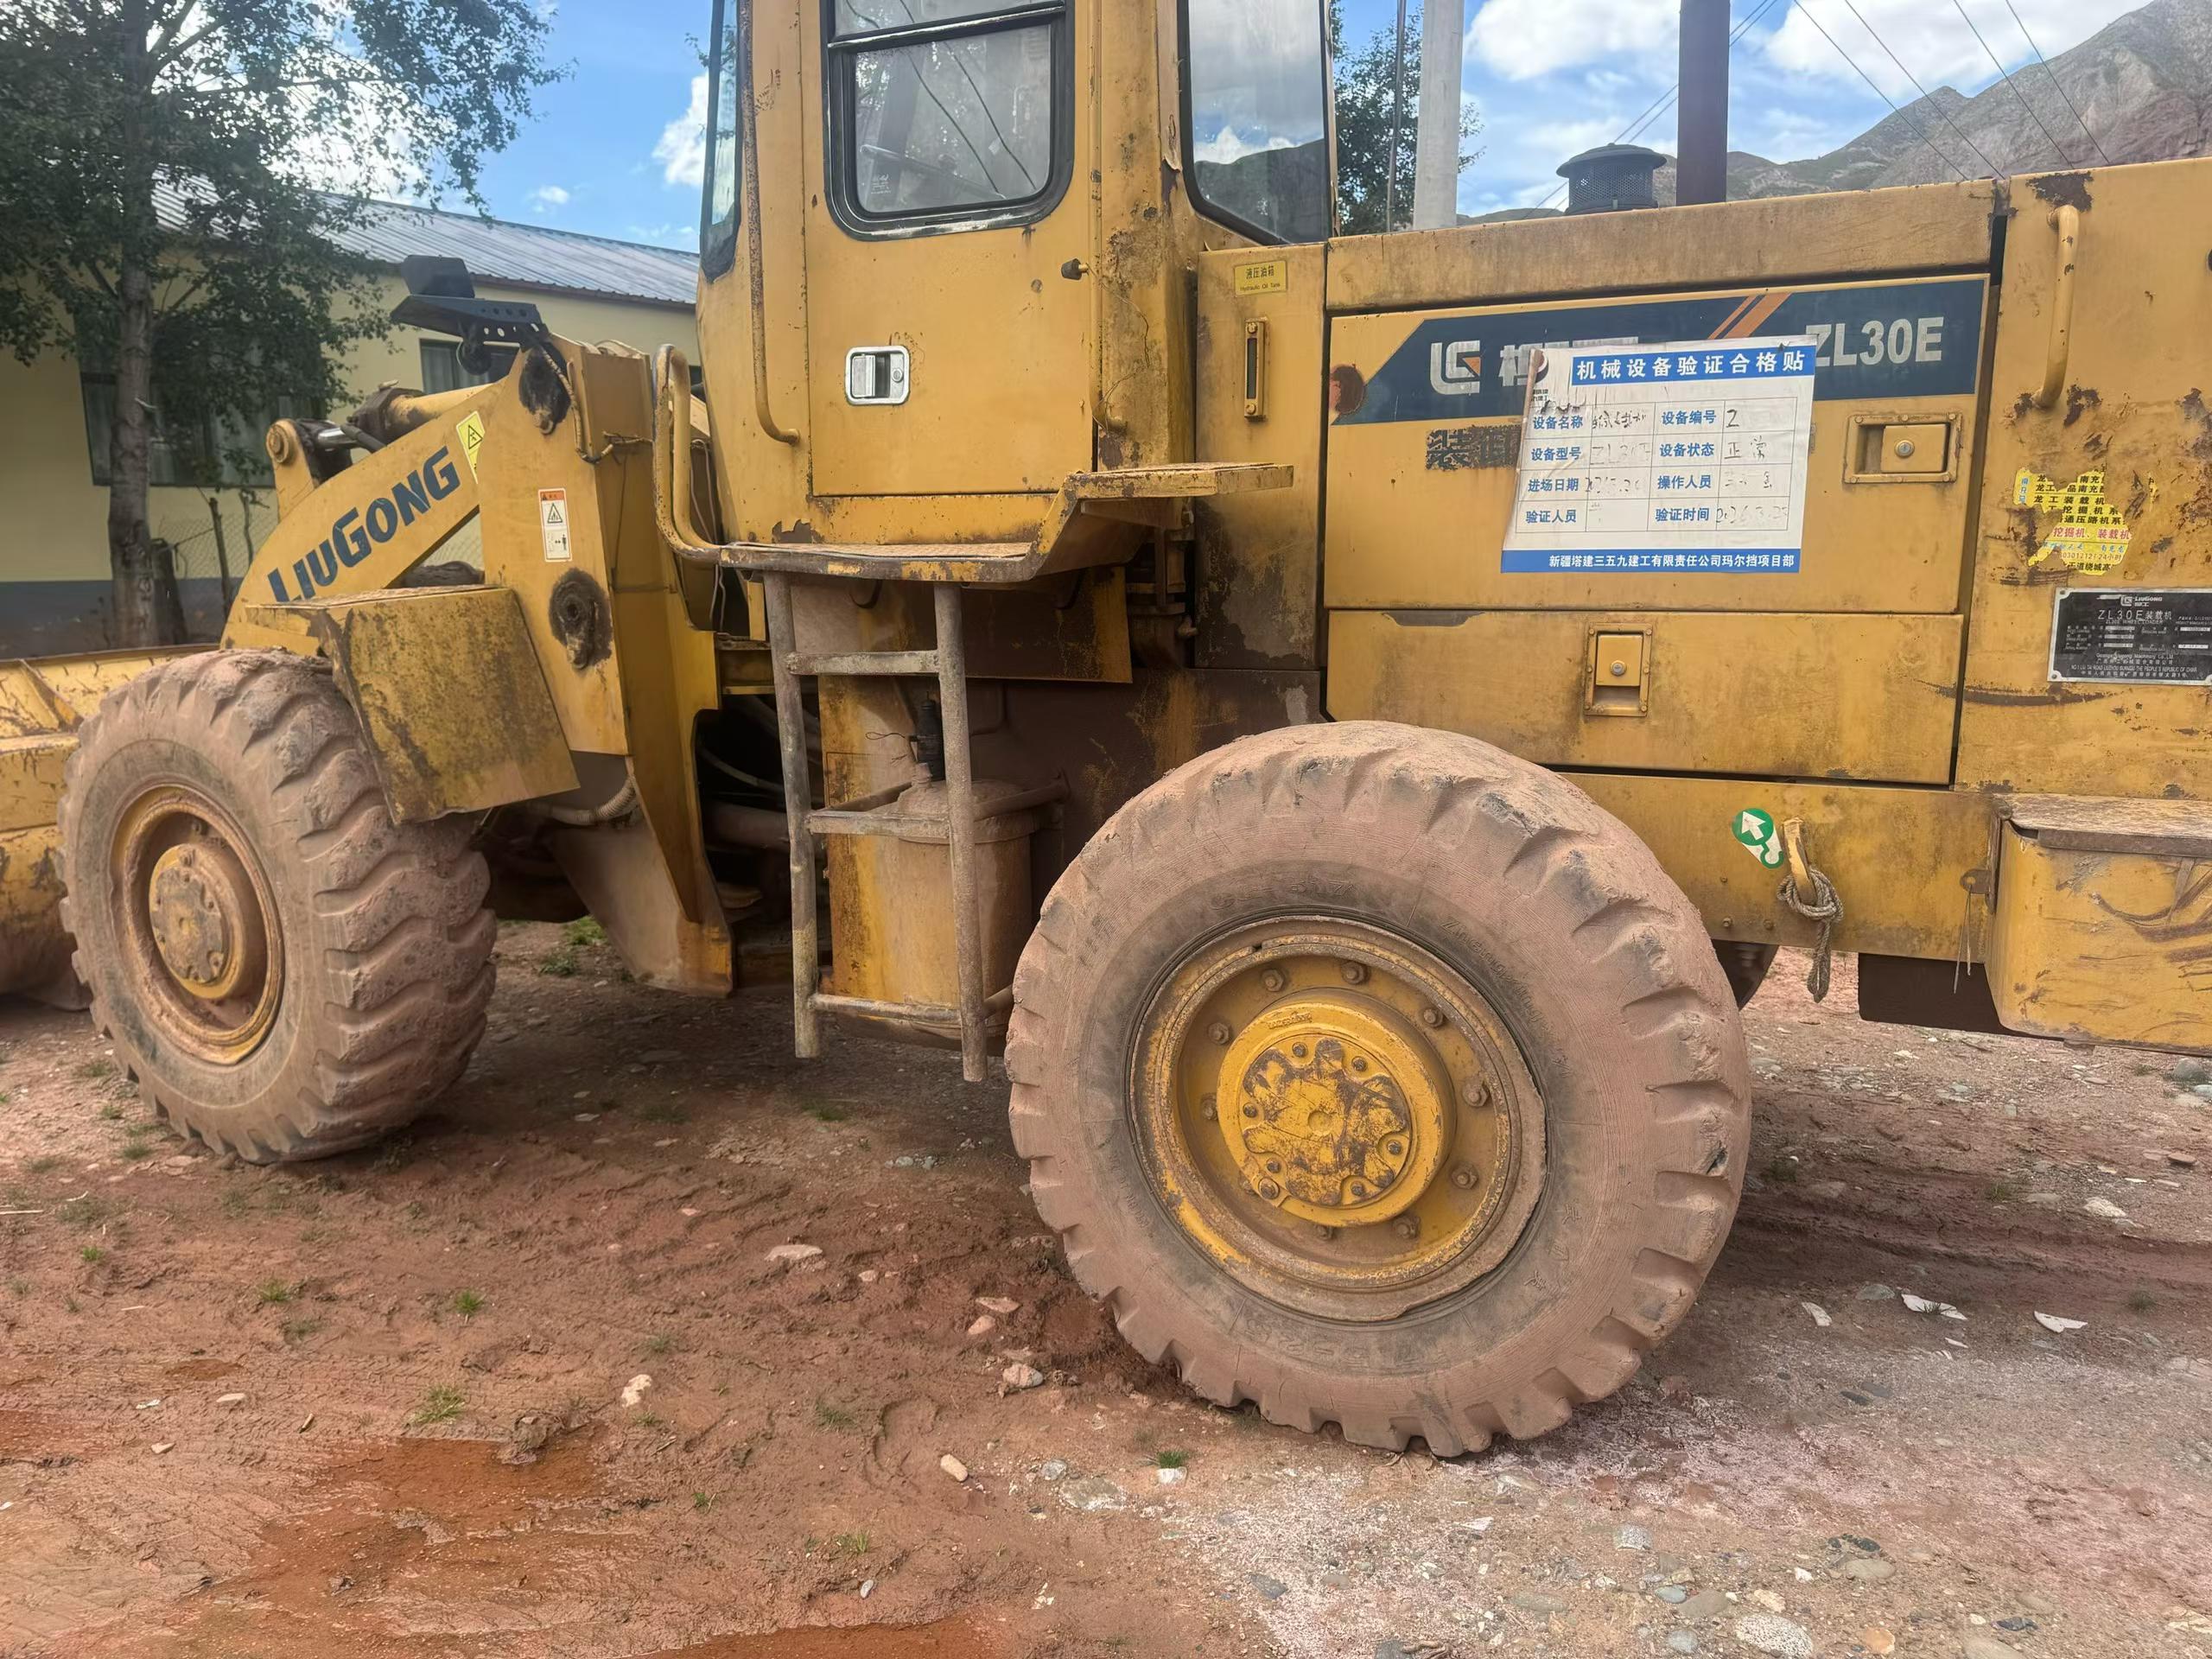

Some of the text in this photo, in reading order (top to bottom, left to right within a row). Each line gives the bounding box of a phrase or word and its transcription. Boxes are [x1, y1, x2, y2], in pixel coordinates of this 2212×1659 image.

[1806, 316, 1944, 367] ZL30E
[1577, 350, 1805, 381] 机械设备验证合格贴
[1533, 415, 1584, 430] 设备名称
[1662, 410, 1716, 425] 设备编号
[1531, 447, 1582, 461] 设备型号
[1659, 442, 1715, 458] 设备状态
[1528, 478, 1580, 493] 进场日期
[1657, 474, 1712, 490] 操作人员
[1526, 509, 1577, 524] 验证人员
[1656, 508, 1710, 522] 验证时间
[266, 446, 461, 602] LIUGONG
[1548, 554, 1795, 568] 新疆塔建三五九建工有限责任公司玛尔挡项目部
